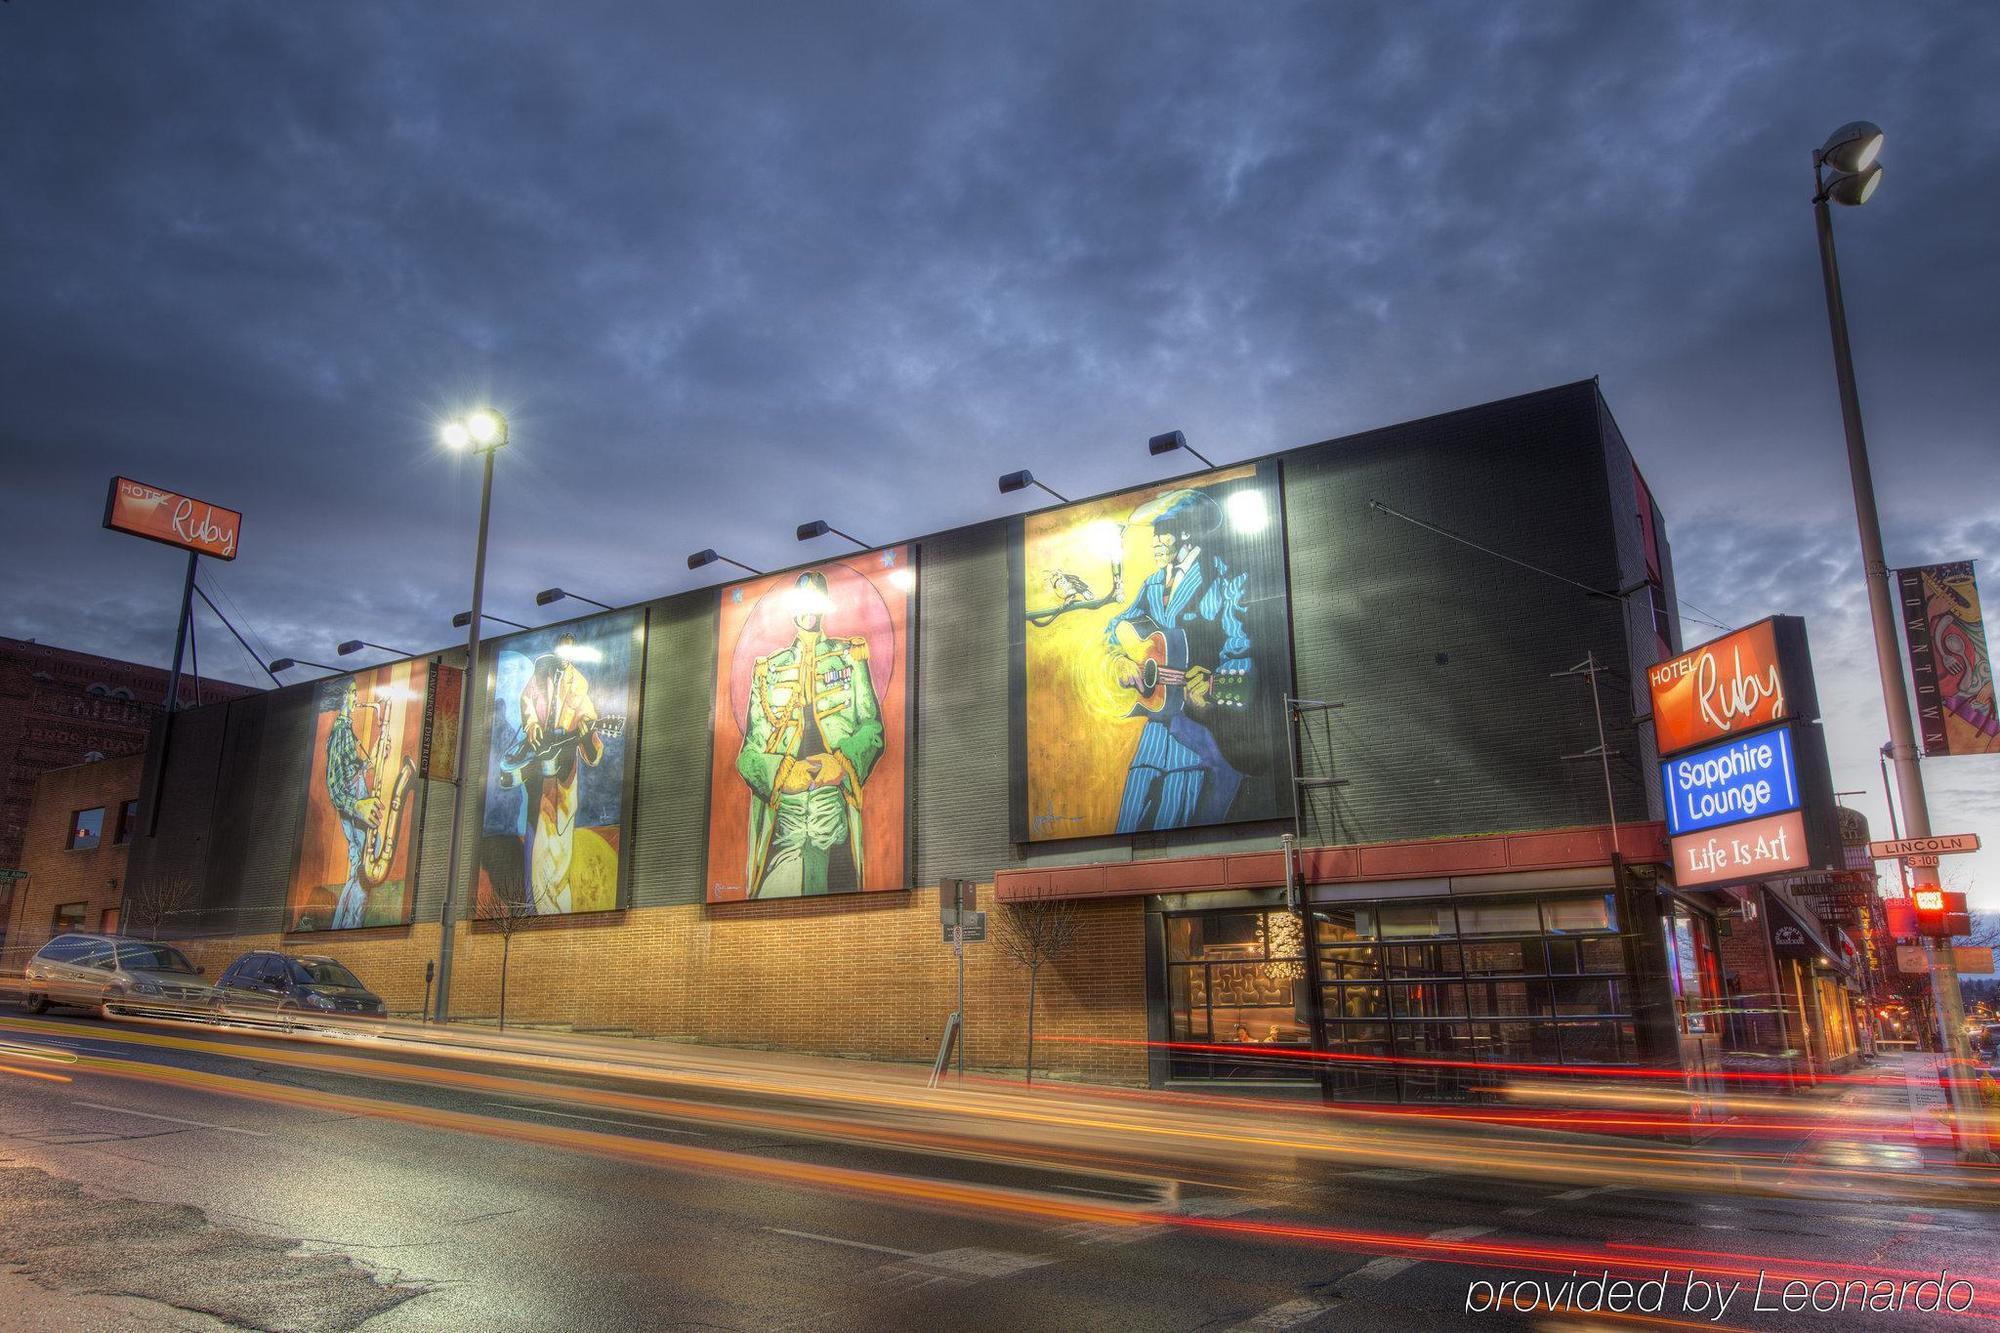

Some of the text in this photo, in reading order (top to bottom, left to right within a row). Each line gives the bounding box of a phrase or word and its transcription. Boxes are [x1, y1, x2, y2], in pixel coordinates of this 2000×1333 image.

[121, 482, 235, 556] HOTEL Ruby
[1902, 577, 1943, 742] DOWNTOWN
[1650, 645, 1785, 731] HOTEL Ruby
[1679, 744, 1773, 790] Sapphire
[1687, 780, 1771, 820] Lounge
[1688, 825, 1790, 873] Life Is Art
[1885, 838, 1962, 854] LINCOLN
